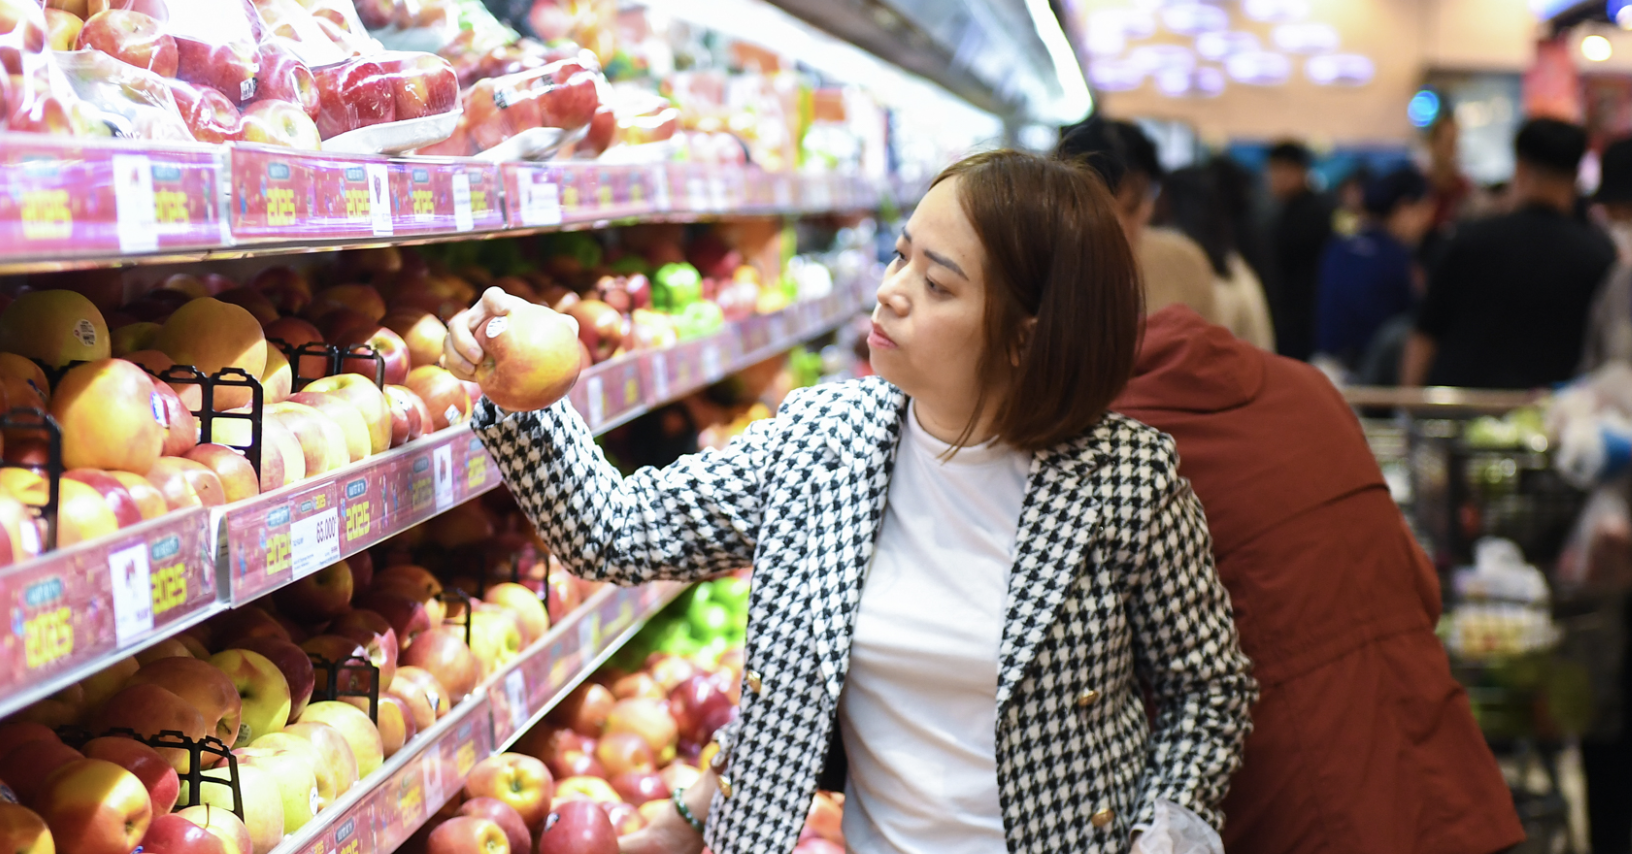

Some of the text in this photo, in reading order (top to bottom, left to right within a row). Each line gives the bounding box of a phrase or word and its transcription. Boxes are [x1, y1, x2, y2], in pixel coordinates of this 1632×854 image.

[267, 188, 295, 226] 2025
[346, 501, 370, 541] 2025
[151, 562, 187, 615] 2025
